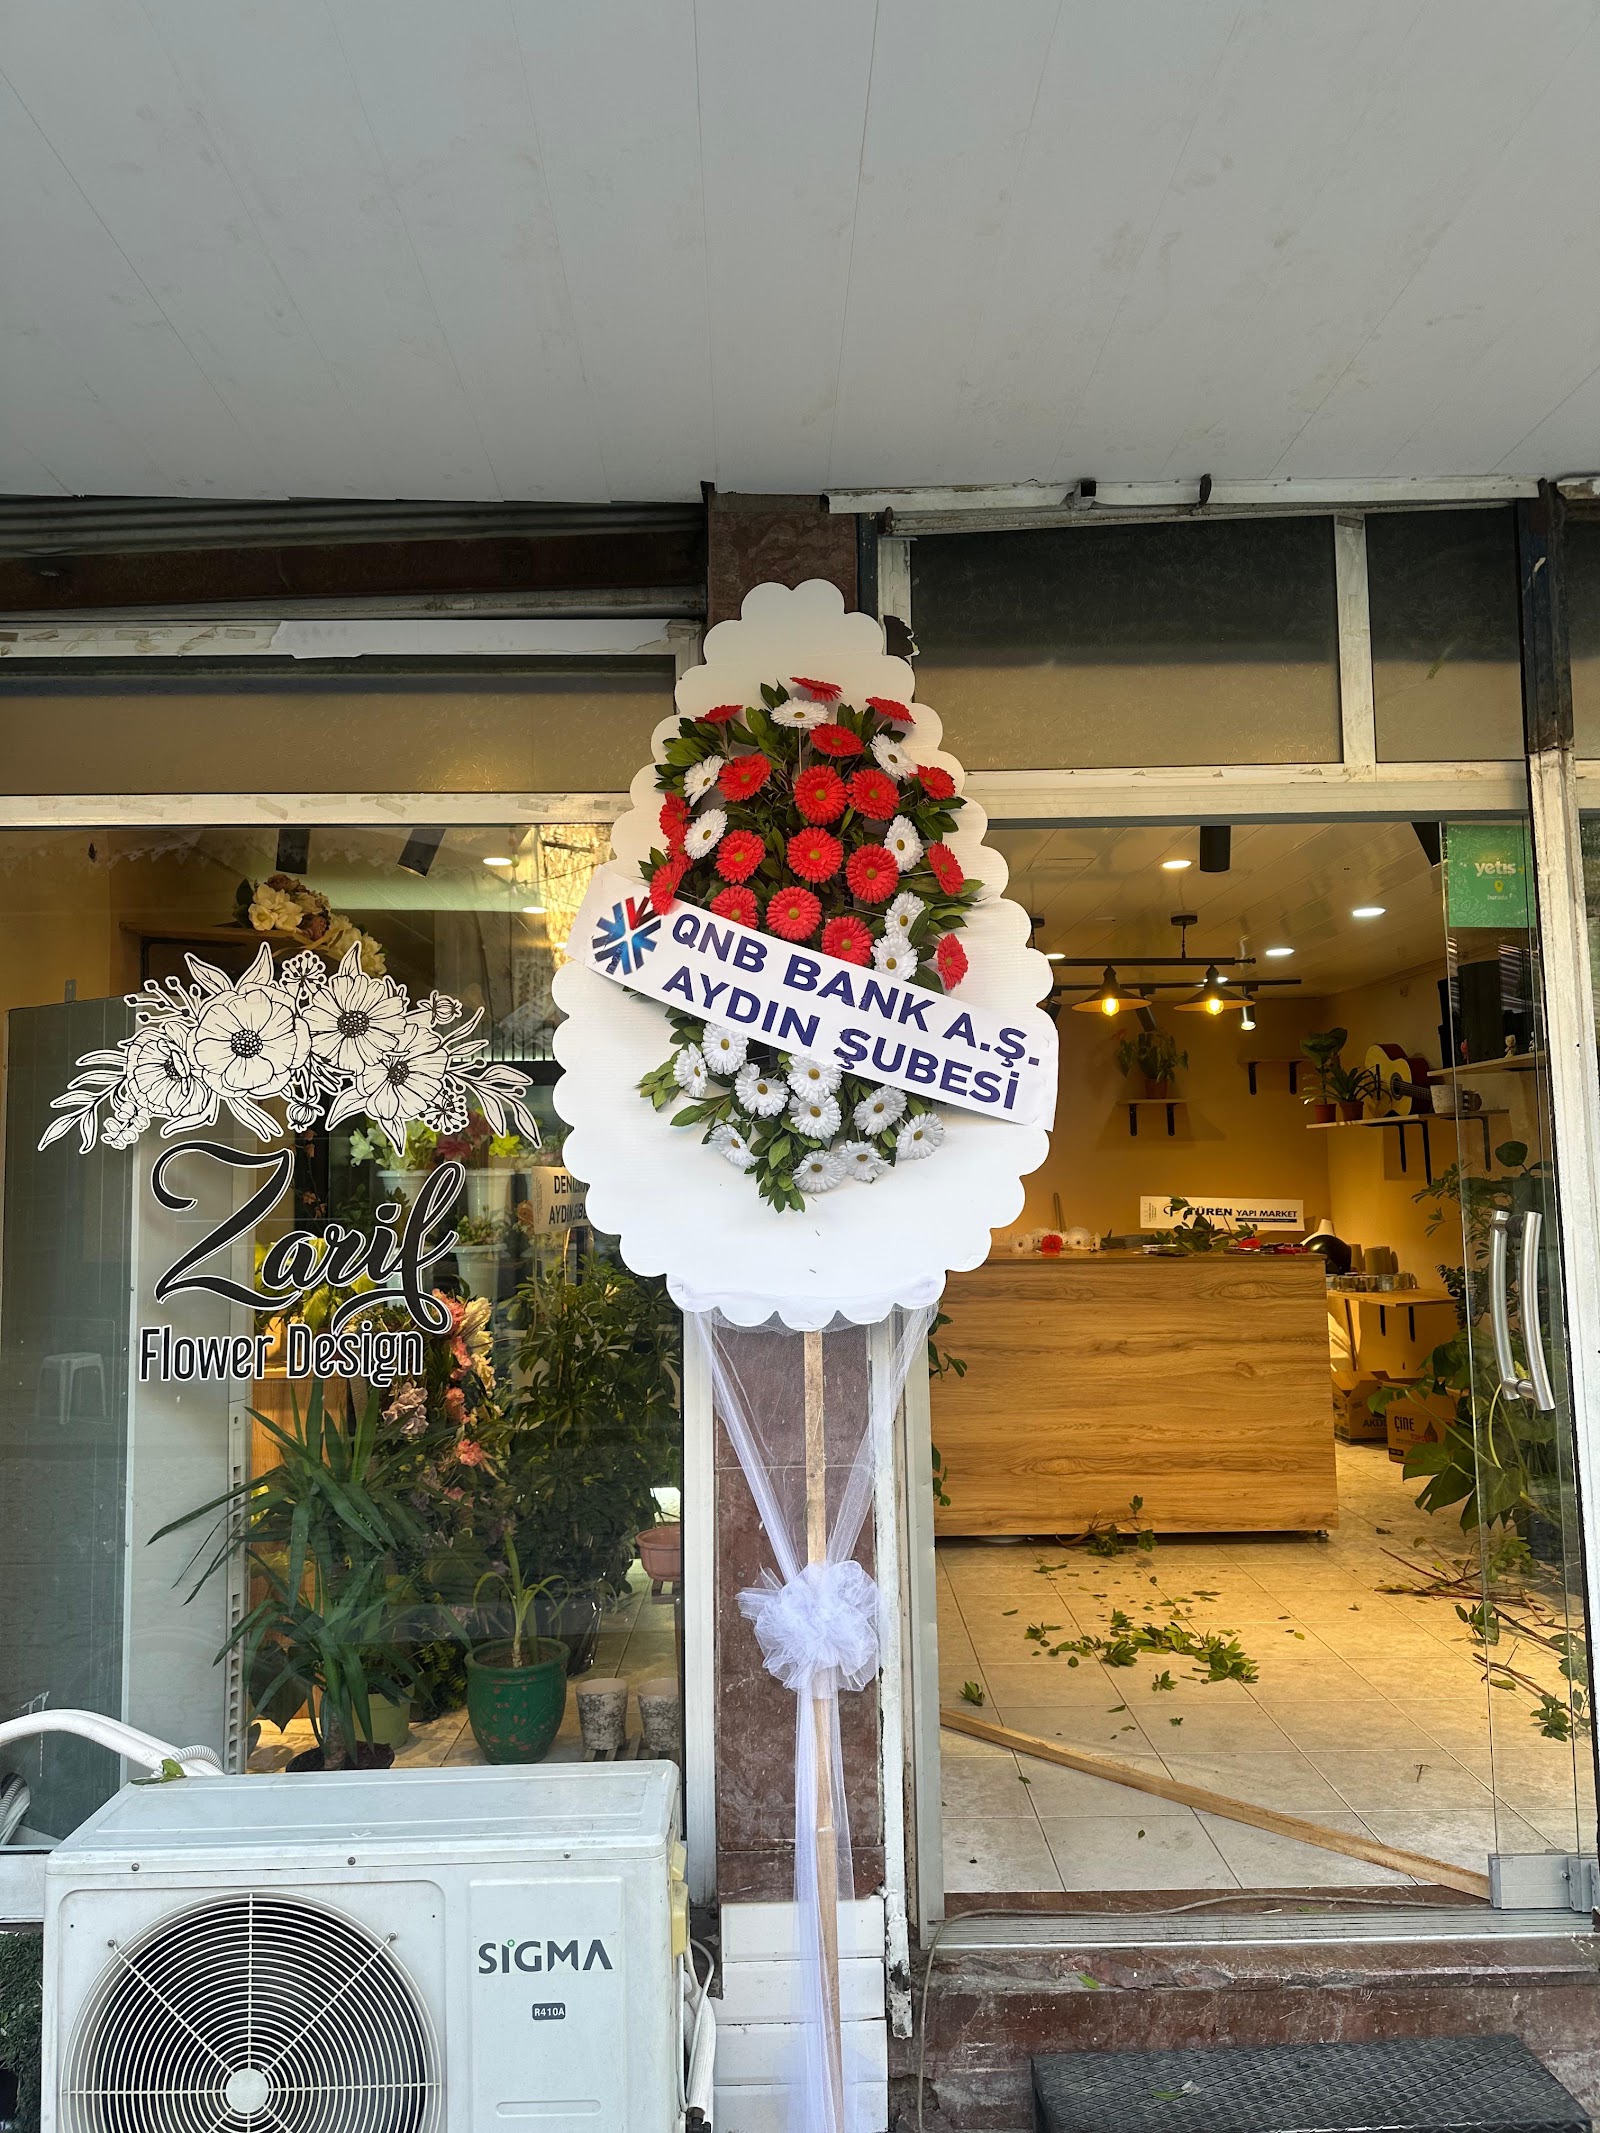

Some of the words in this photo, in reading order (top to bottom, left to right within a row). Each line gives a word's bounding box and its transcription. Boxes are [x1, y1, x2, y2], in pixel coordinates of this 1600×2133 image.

[662, 965, 821, 1047] AYDIN
[833, 1027, 1020, 1111] ŞUBESİ
[671, 913, 769, 973] QNB
[783, 954, 936, 1033] BANK
[942, 1012, 1040, 1067] A.Ş.
[151, 1140, 466, 1334] Zarif
[1235, 1209, 1257, 1217] YAPI
[1259, 1210, 1298, 1218] MARKET
[139, 1325, 273, 1382] Flower
[286, 1322, 424, 1388] Design
[534, 2007, 565, 2017] R410A
